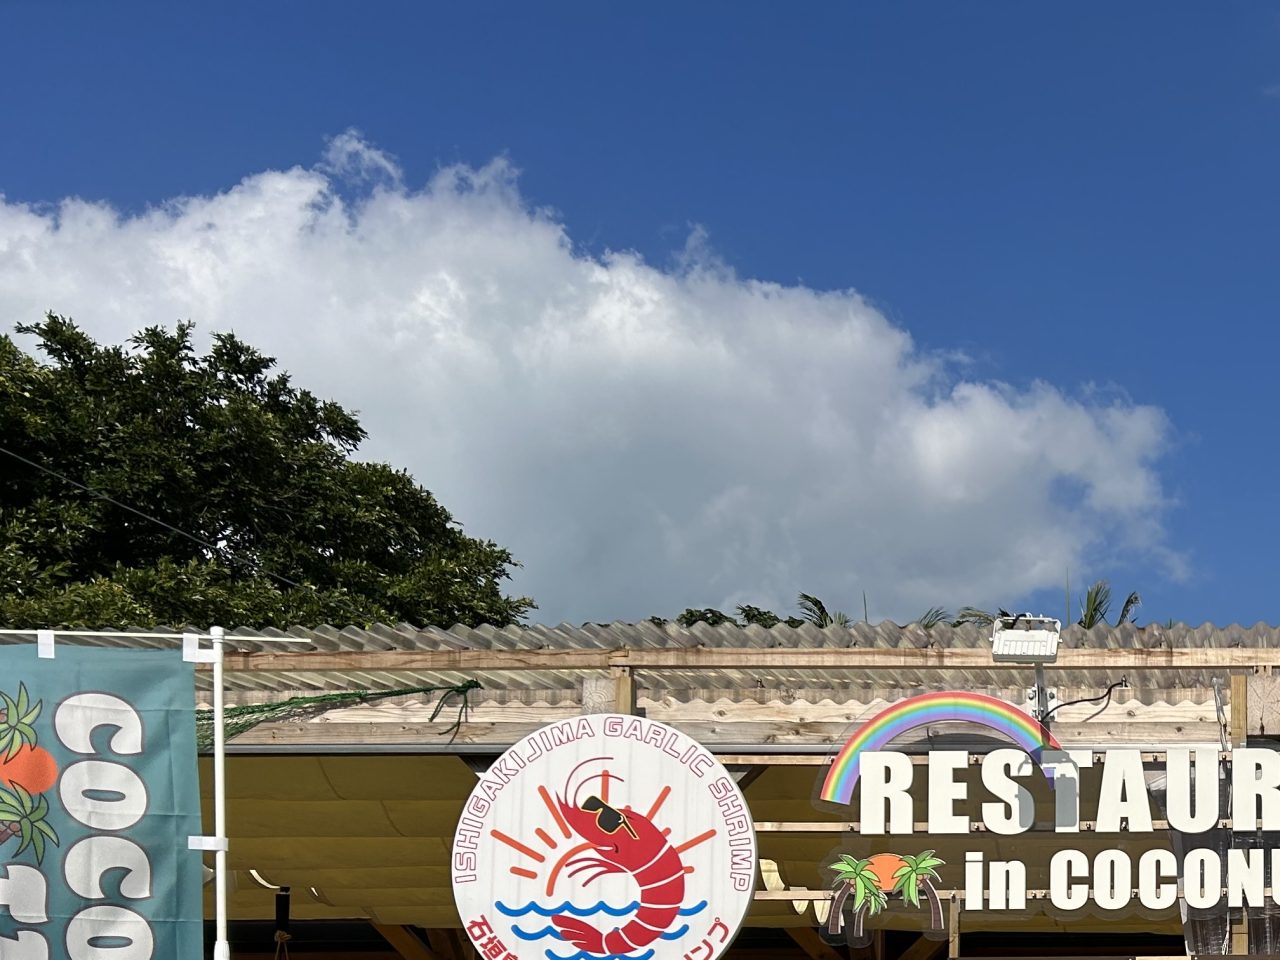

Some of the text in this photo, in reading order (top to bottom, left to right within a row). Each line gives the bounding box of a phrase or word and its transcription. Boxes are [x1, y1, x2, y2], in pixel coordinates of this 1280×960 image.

[455, 716, 755, 892] ISHIGAKIJIMA GARLIC SHRIMP
[964, 850, 1027, 910] in
